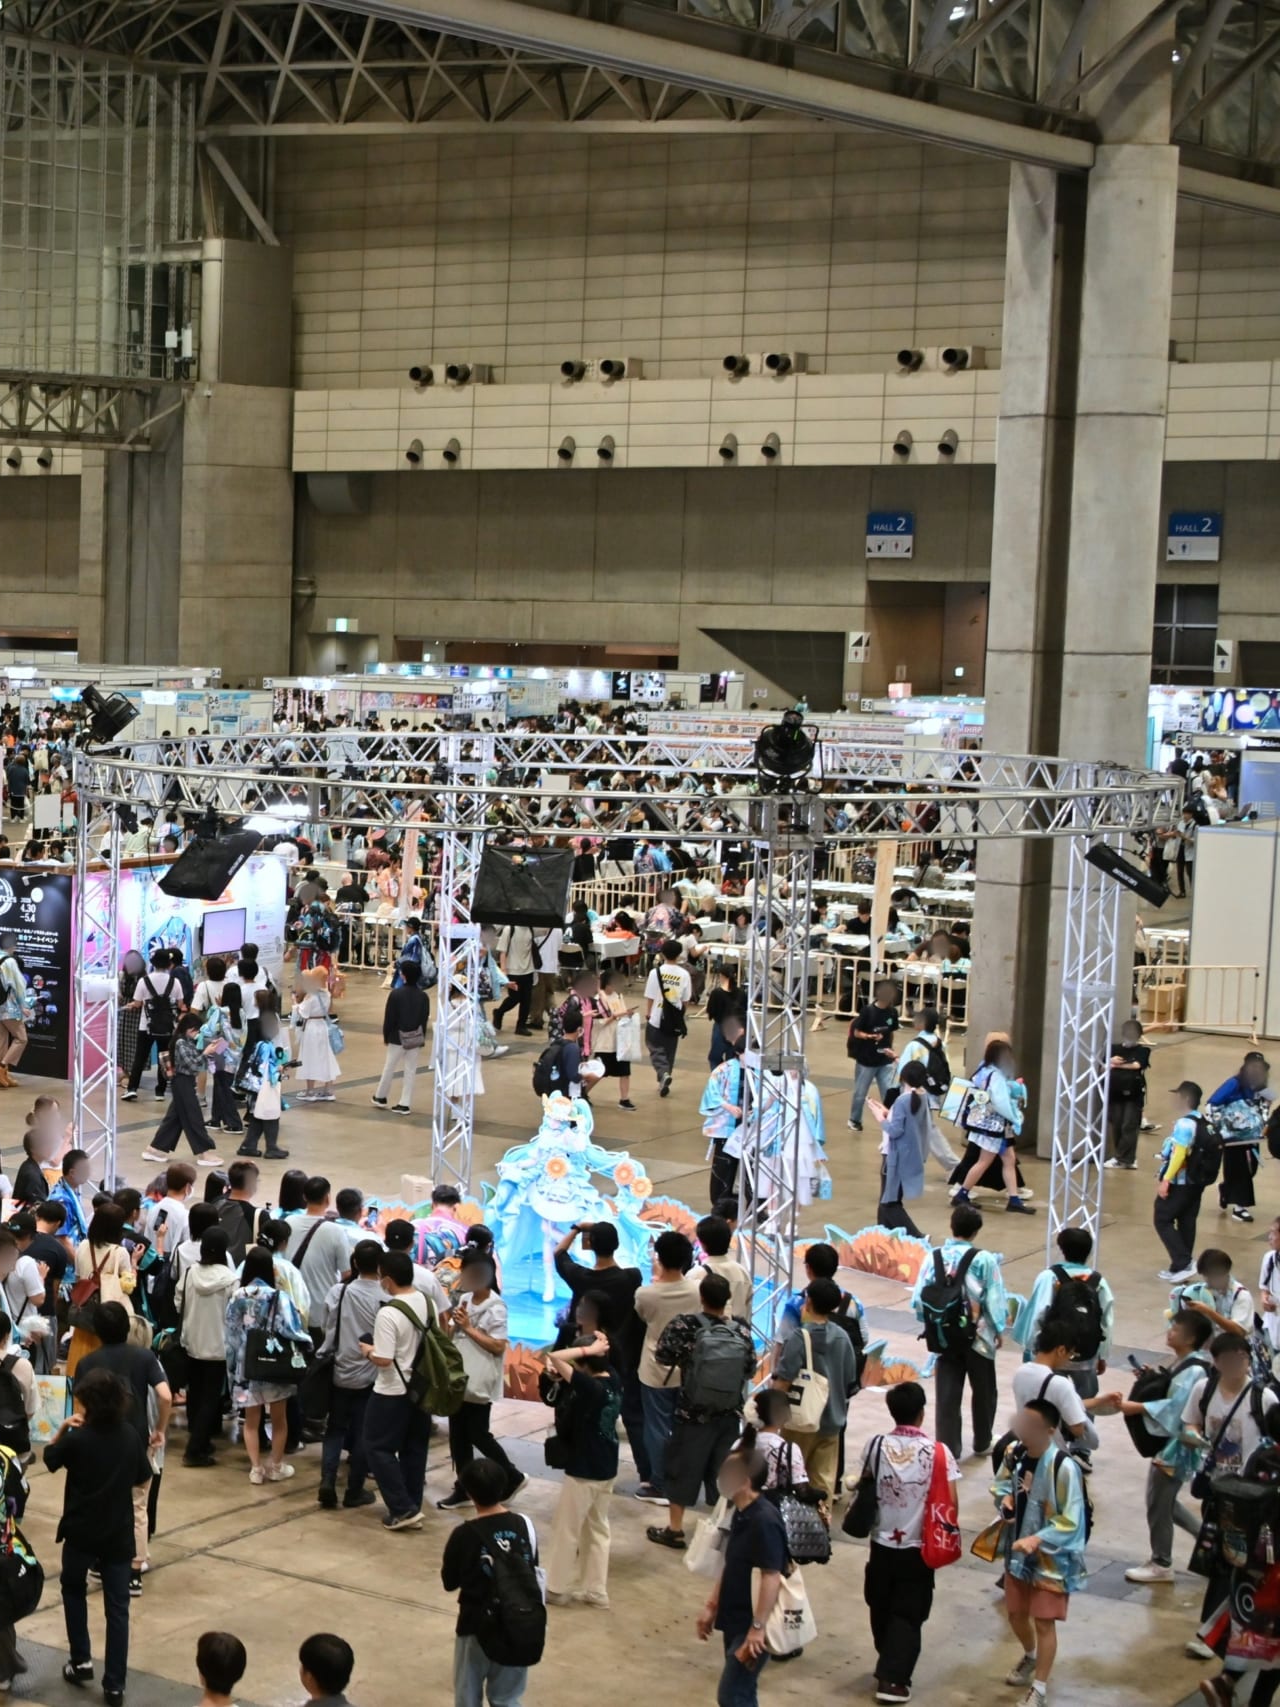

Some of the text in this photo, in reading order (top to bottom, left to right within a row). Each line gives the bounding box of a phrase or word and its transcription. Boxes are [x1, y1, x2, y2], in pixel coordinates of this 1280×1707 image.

[873, 517, 906, 531] HALL 2
[1175, 517, 1212, 532] HALL 2
[20, 903, 37, 914] 4.30
